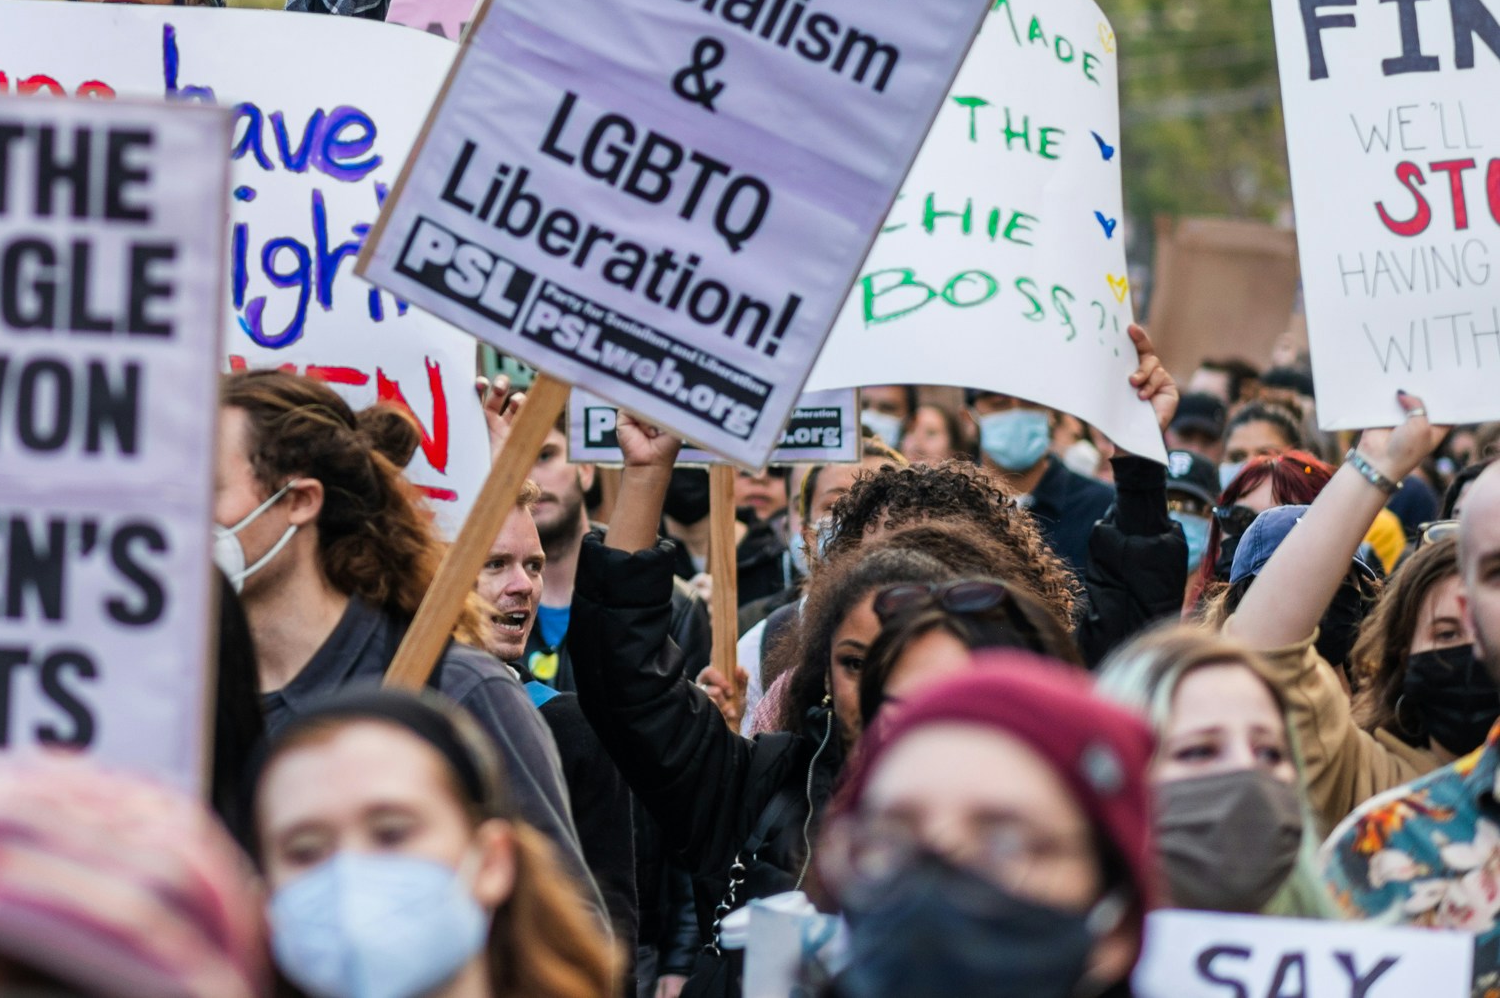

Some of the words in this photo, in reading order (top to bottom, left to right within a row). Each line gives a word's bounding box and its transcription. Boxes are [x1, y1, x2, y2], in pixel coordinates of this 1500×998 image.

[671, 35, 726, 113] &
[950, 93, 1067, 162] THE
[1350, 100, 1484, 154] WE'LL
[539, 90, 772, 255] LGBTQ
[402, 222, 517, 321] PSL
[439, 139, 804, 358] Liberation!
[1337, 237, 1492, 299] HAVING
[523, 301, 759, 436] PSLweb.org
